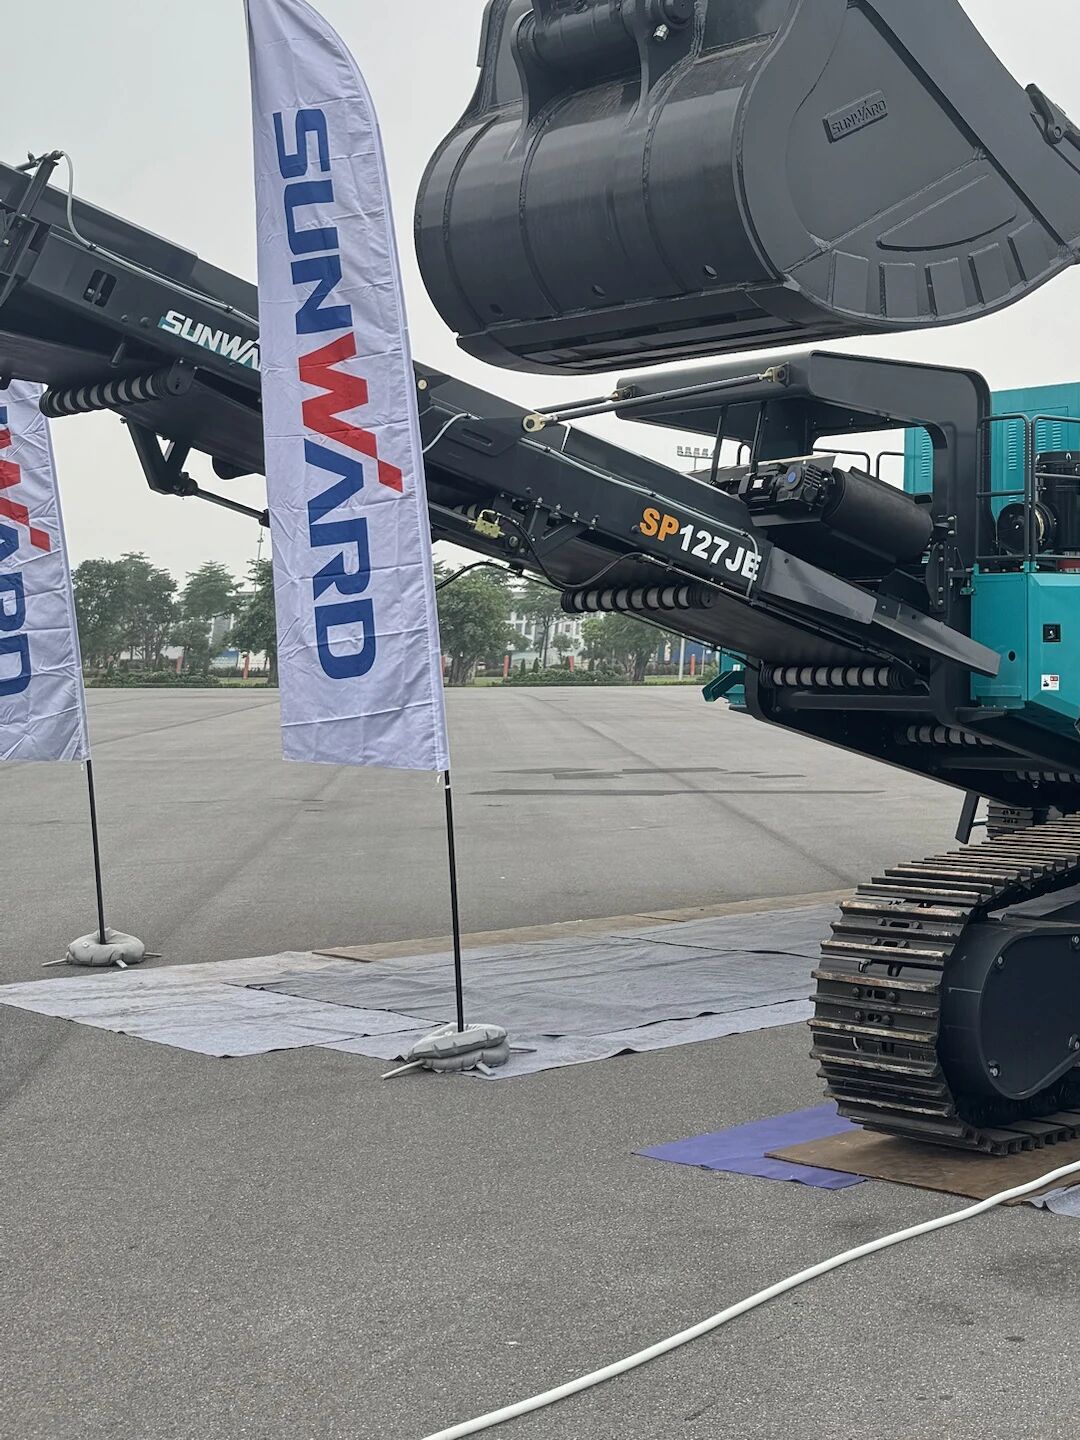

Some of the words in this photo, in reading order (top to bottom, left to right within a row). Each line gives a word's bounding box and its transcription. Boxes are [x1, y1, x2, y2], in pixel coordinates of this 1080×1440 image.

[159, 309, 261, 372] SUNWA
[272, 107, 404, 680] SUNWARD
[639, 507, 762, 581] SP127JE
